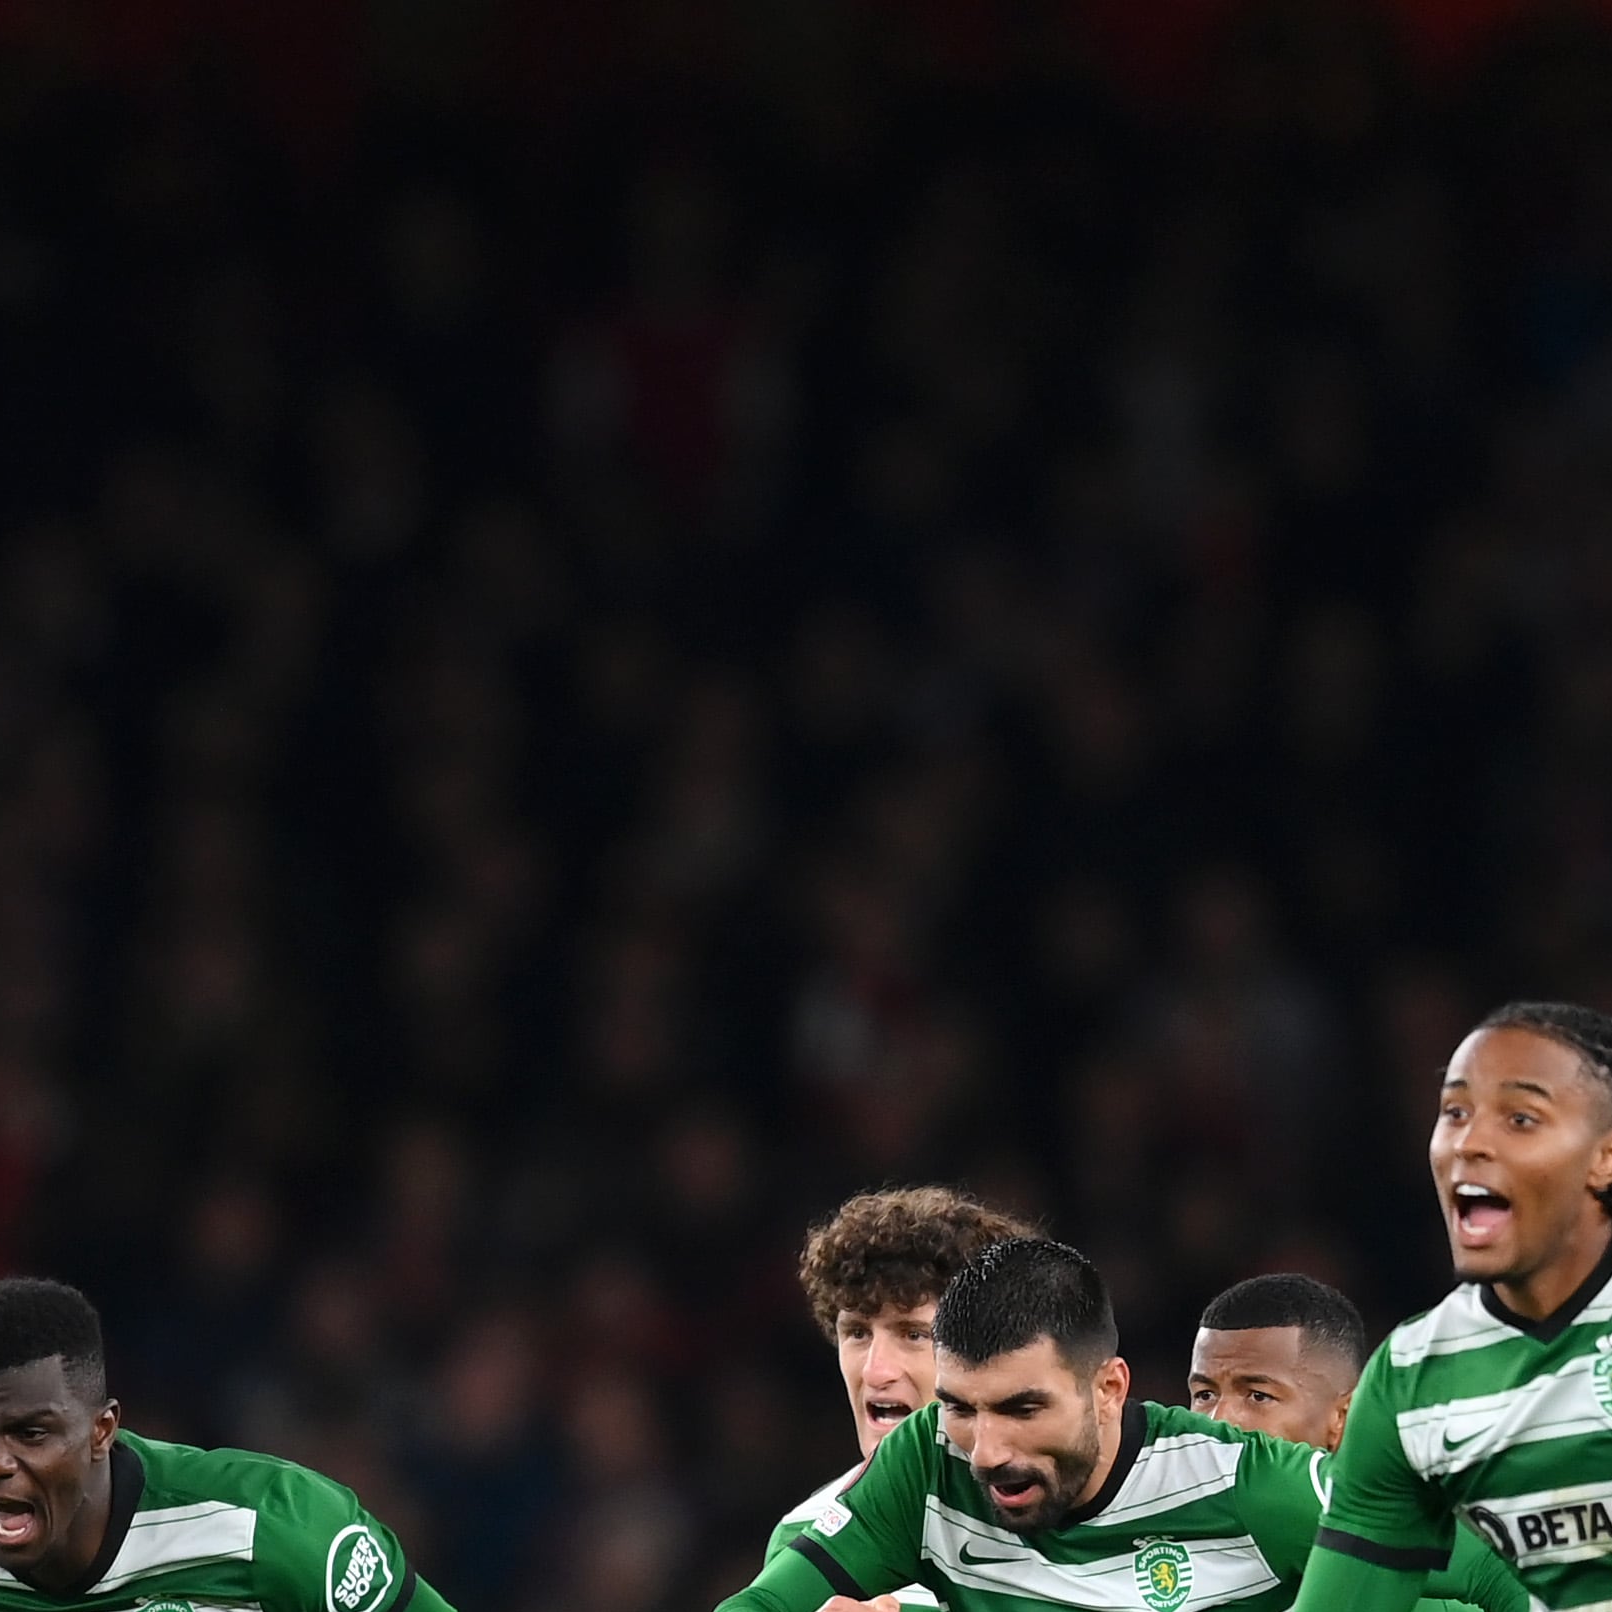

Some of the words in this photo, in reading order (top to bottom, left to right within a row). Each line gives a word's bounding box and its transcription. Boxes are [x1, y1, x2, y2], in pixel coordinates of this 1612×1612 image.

[334, 1535, 370, 1603] SUPER
[344, 1548, 379, 1609] BOCK
[1138, 1547, 1185, 1569] SPORTING
